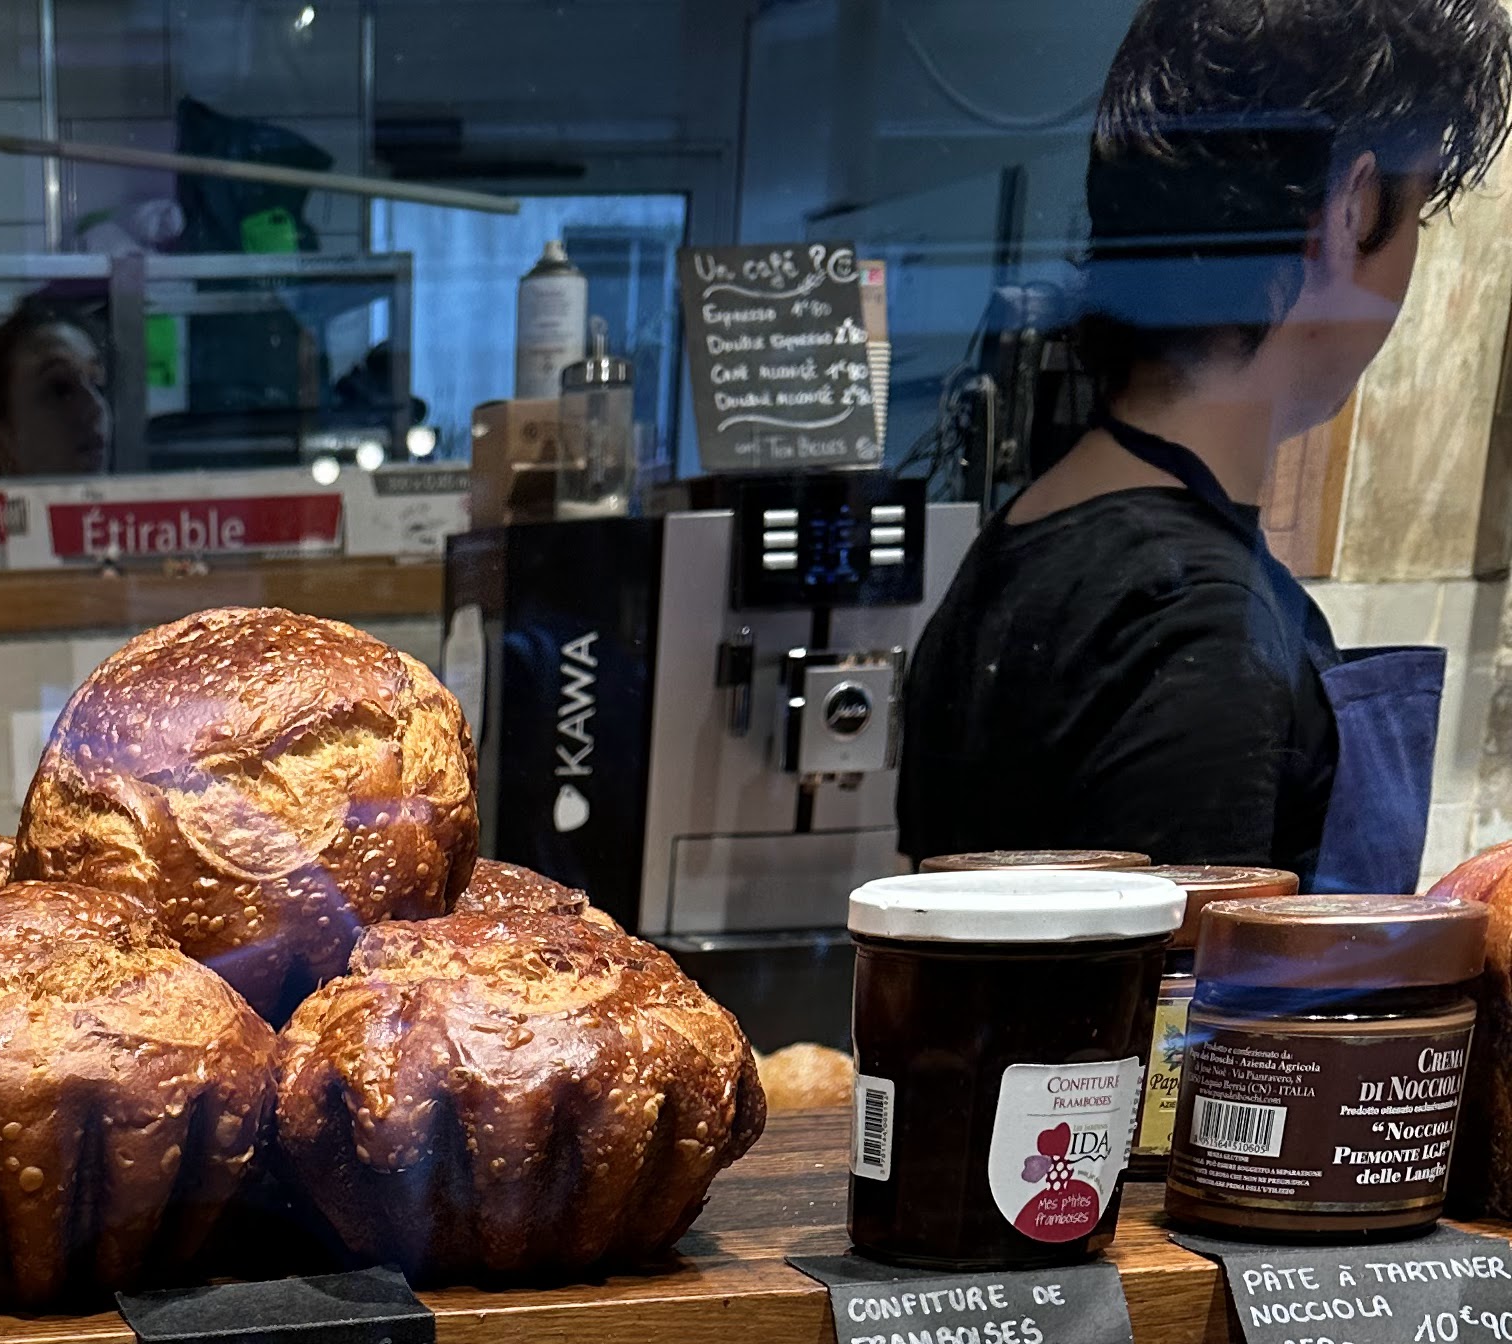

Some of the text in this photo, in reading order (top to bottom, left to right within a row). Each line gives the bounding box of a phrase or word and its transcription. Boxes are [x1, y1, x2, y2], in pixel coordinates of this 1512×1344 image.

[695, 253, 735, 281] Un
[743, 250, 798, 289] café
[83, 506, 246, 553] Étirable
[554, 631, 600, 776] KAWA
[1232, 1068, 1245, 1079] Via
[1240, 1058, 1276, 1069] Azienda
[1278, 1060, 1320, 1074] Agricola
[1150, 1073, 1180, 1095] Pap
[1247, 1081, 1272, 1096] (CN)
[1279, 1086, 1315, 1097] ITALIA
[1359, 1082, 1384, 1101] DI
[1053, 1095, 1112, 1110] FRAMBOISES
[1070, 1130, 1108, 1155] IDA
[1233, 1143, 1265, 1154] 510605
[1332, 1146, 1420, 1164] PIEMONTE
[1356, 1169, 1401, 1184] delle
[1038, 1197, 1058, 1210] Mes
[1035, 1212, 1089, 1226] framboises
[1243, 1256, 1512, 1295] PÂTE À TARTINER
[848, 1284, 1065, 1322] CONFITURE DE
[1249, 1295, 1393, 1327] NOCCIOLA
